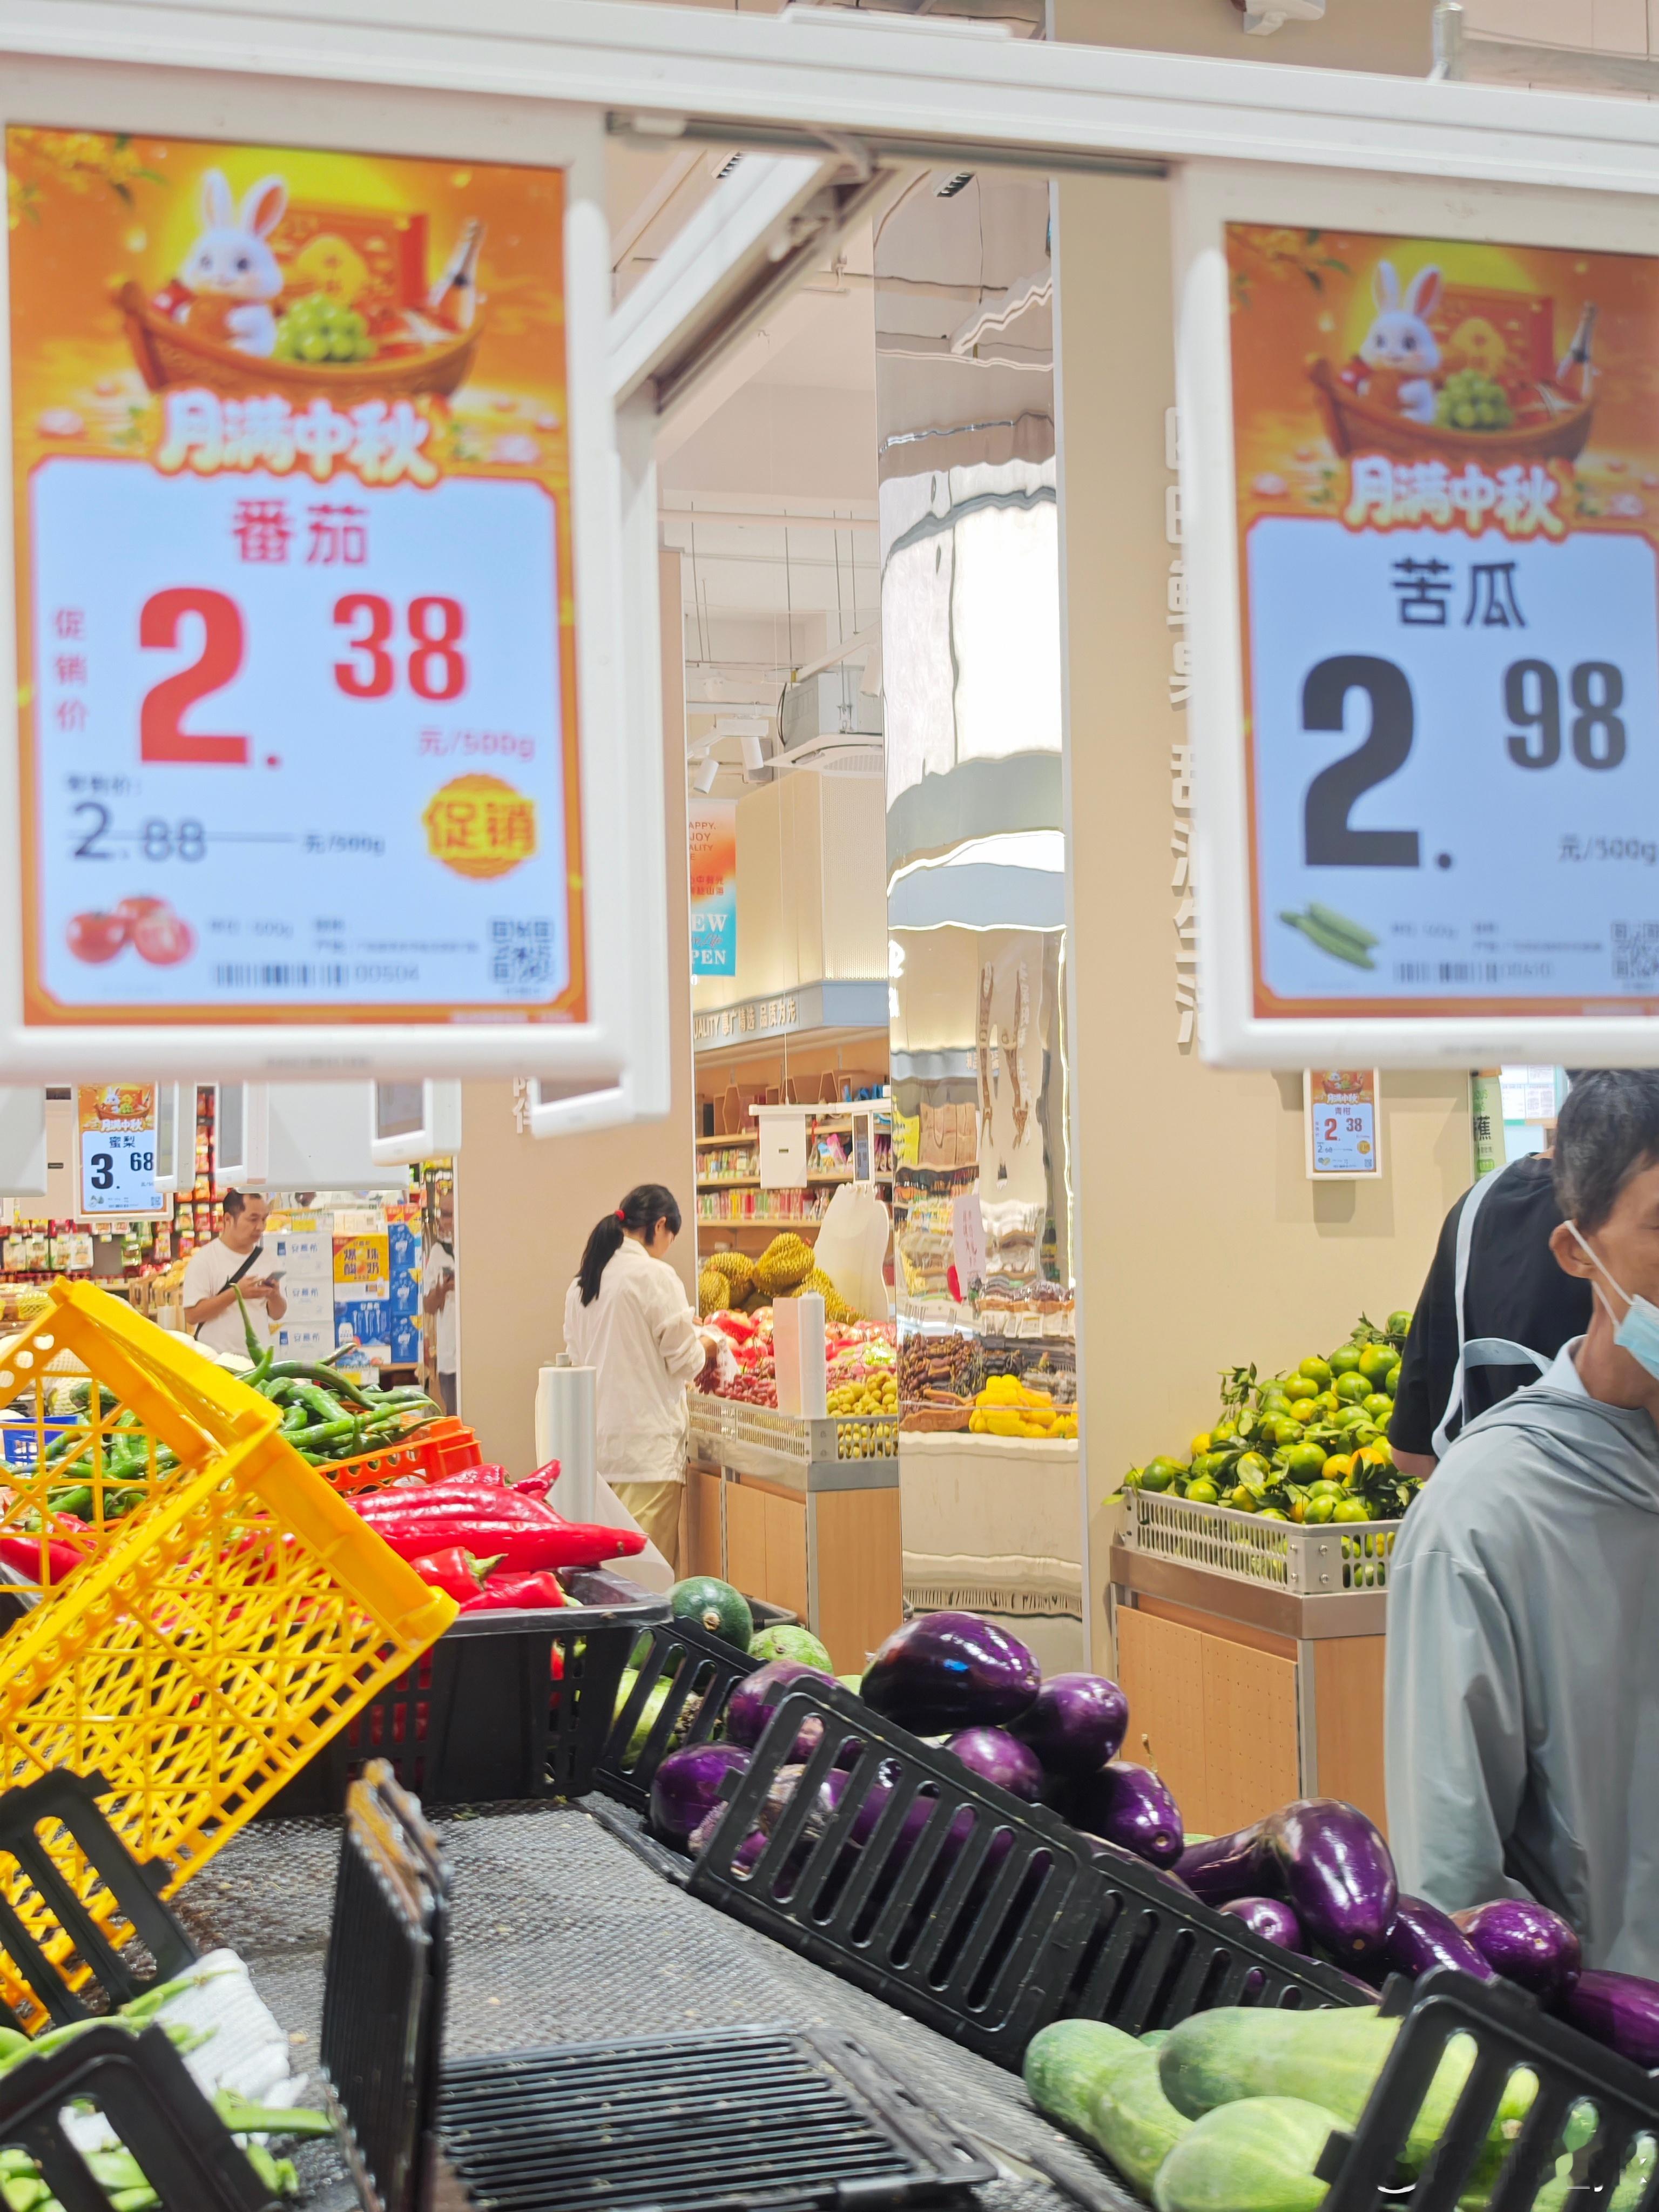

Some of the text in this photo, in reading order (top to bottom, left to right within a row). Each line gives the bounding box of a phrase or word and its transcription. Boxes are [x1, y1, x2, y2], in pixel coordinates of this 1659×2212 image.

[161, 396, 436, 485] 月满中秋
[1348, 459, 1563, 534] 月满中秋
[233, 498, 369, 566] 番茄
[1392, 558, 1528, 629] 苦瓜
[419, 729, 535, 759] 元/500g
[427, 799, 535, 854] 促销
[1558, 834, 1657, 865] 元/500g
[109, 1136, 136, 1148] 蜜梨
